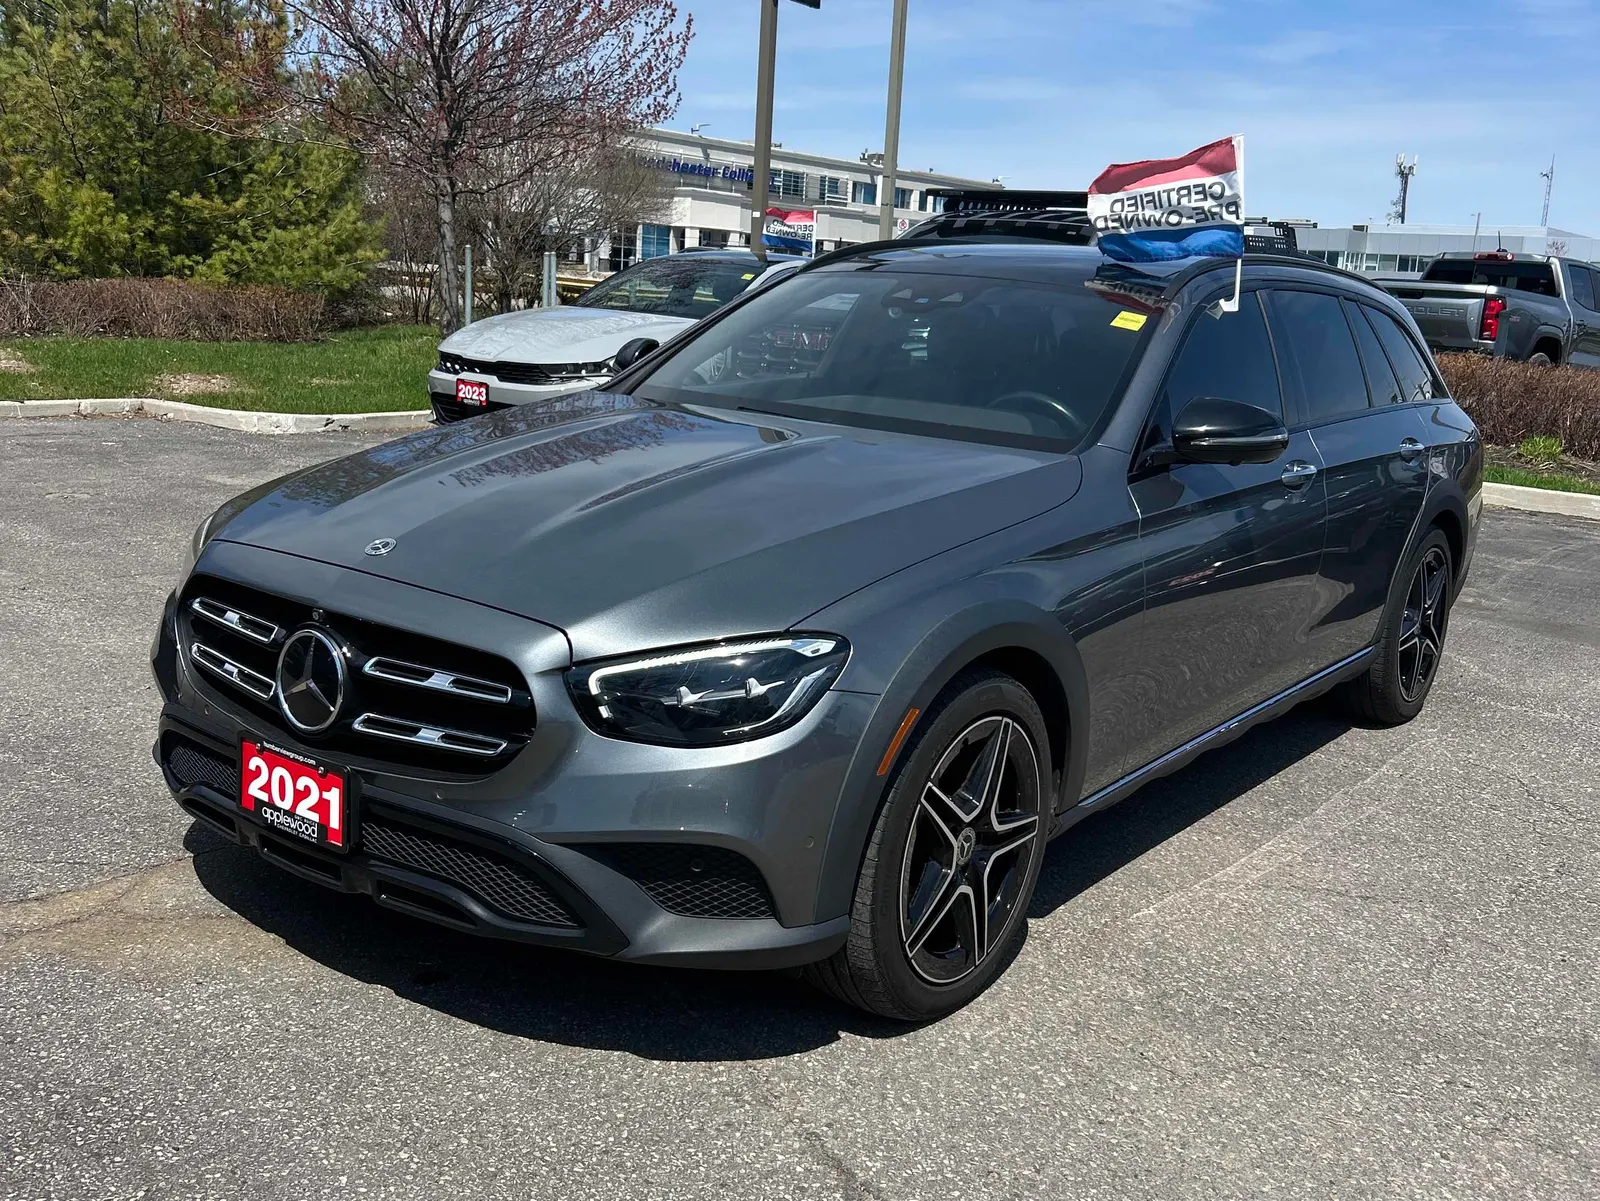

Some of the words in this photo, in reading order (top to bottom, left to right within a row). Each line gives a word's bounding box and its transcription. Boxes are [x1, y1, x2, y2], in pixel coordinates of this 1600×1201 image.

[458, 384, 487, 401] 2023
[247, 756, 340, 830] 2021
[261, 806, 318, 838] applewood
